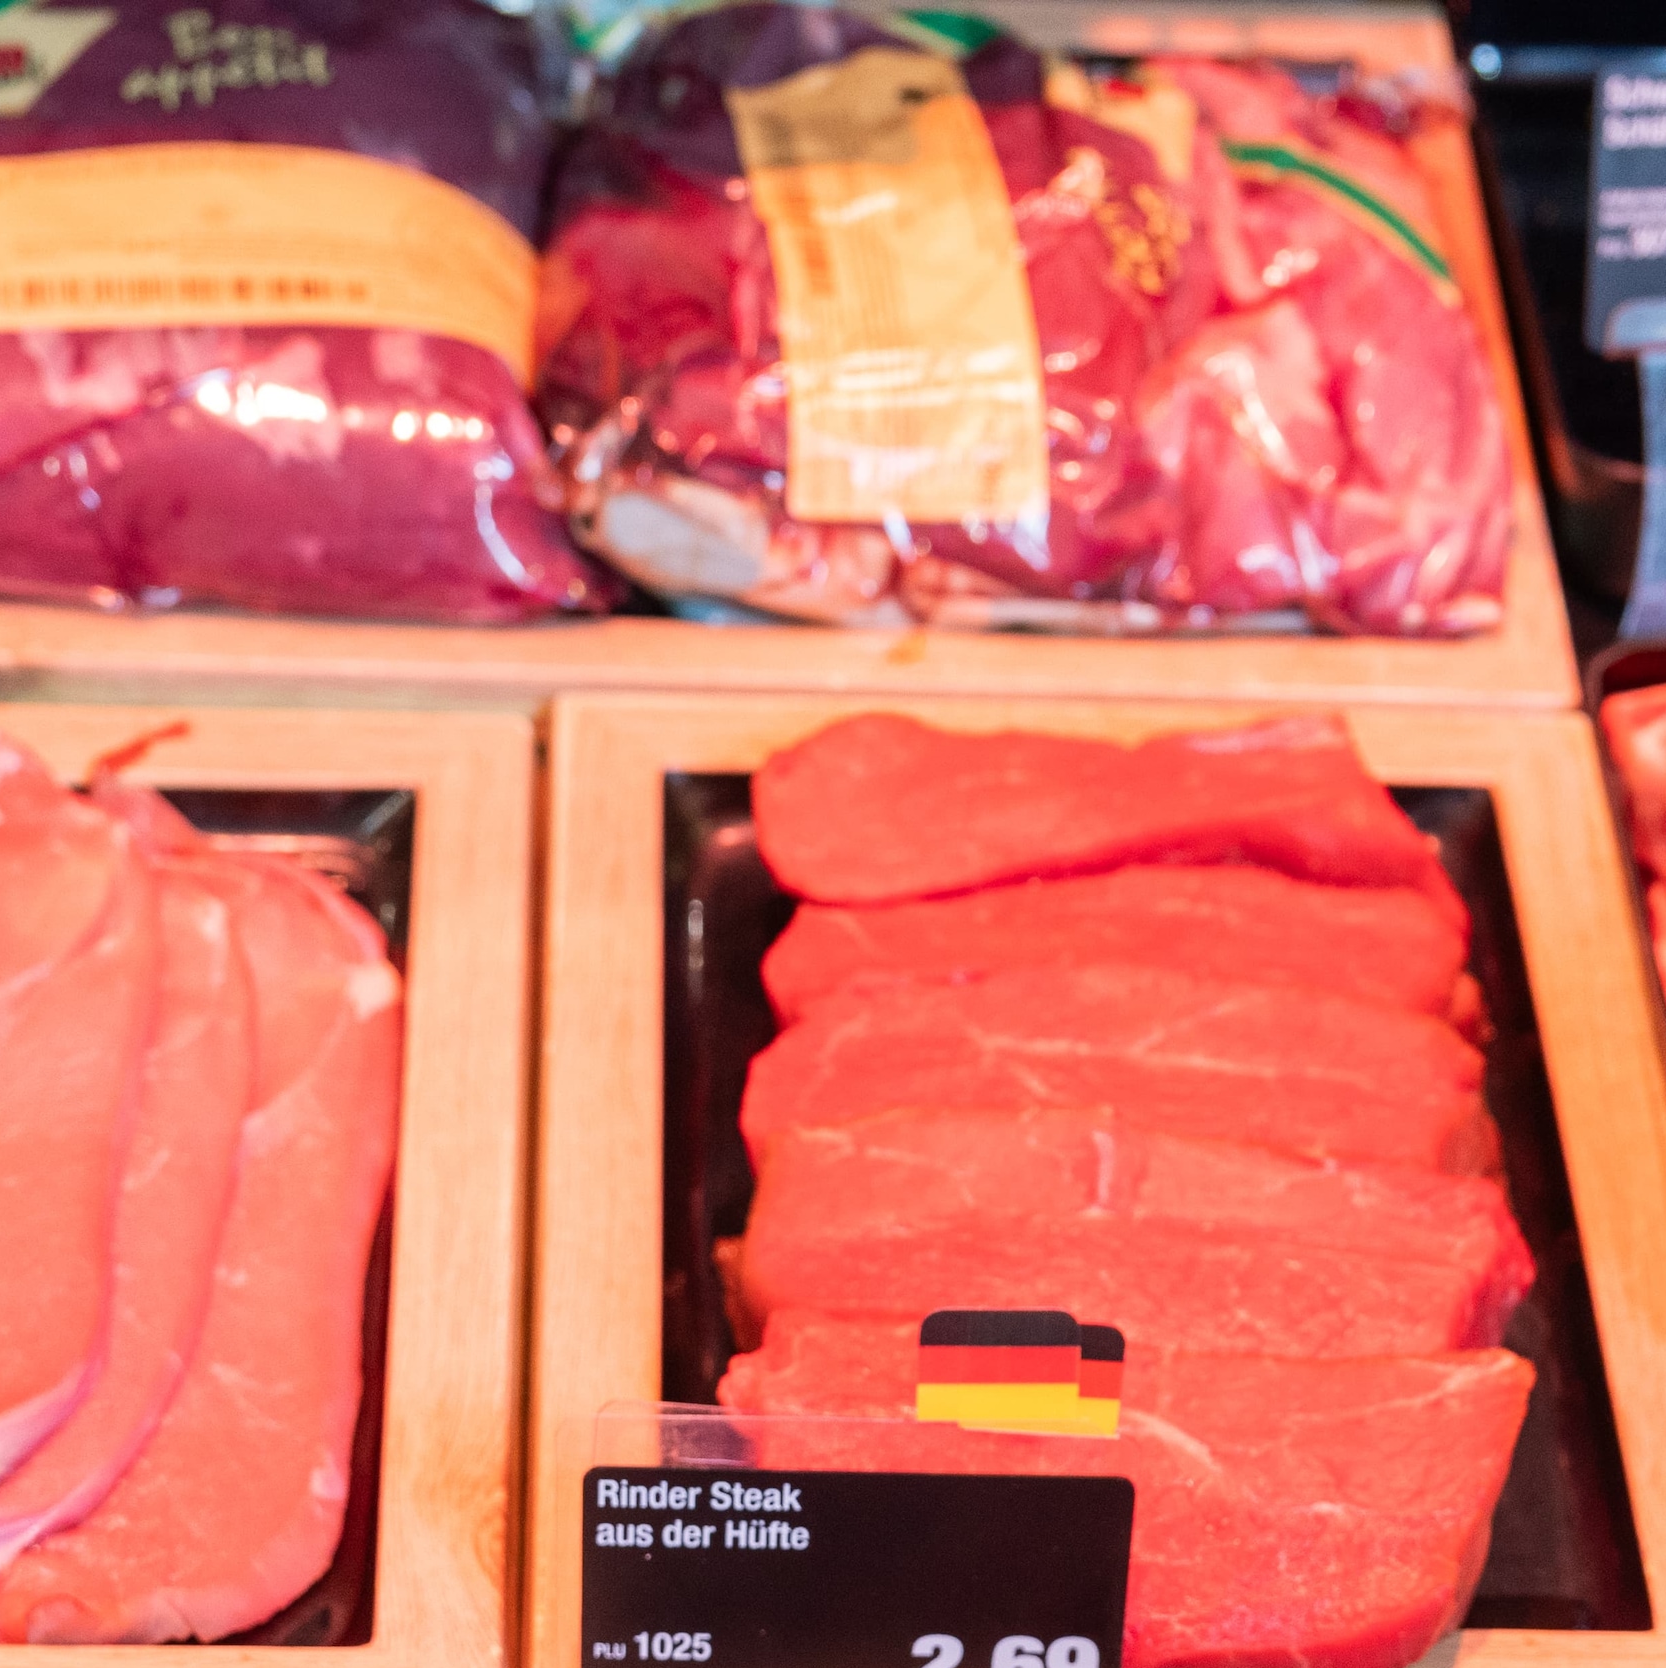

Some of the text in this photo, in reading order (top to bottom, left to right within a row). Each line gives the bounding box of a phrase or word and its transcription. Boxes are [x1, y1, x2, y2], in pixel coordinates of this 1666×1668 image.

[596, 1479, 802, 1513] Rinder Steak
[595, 1519, 810, 1551] aus der Hüfte
[593, 1632, 712, 1663] PLU 1025
